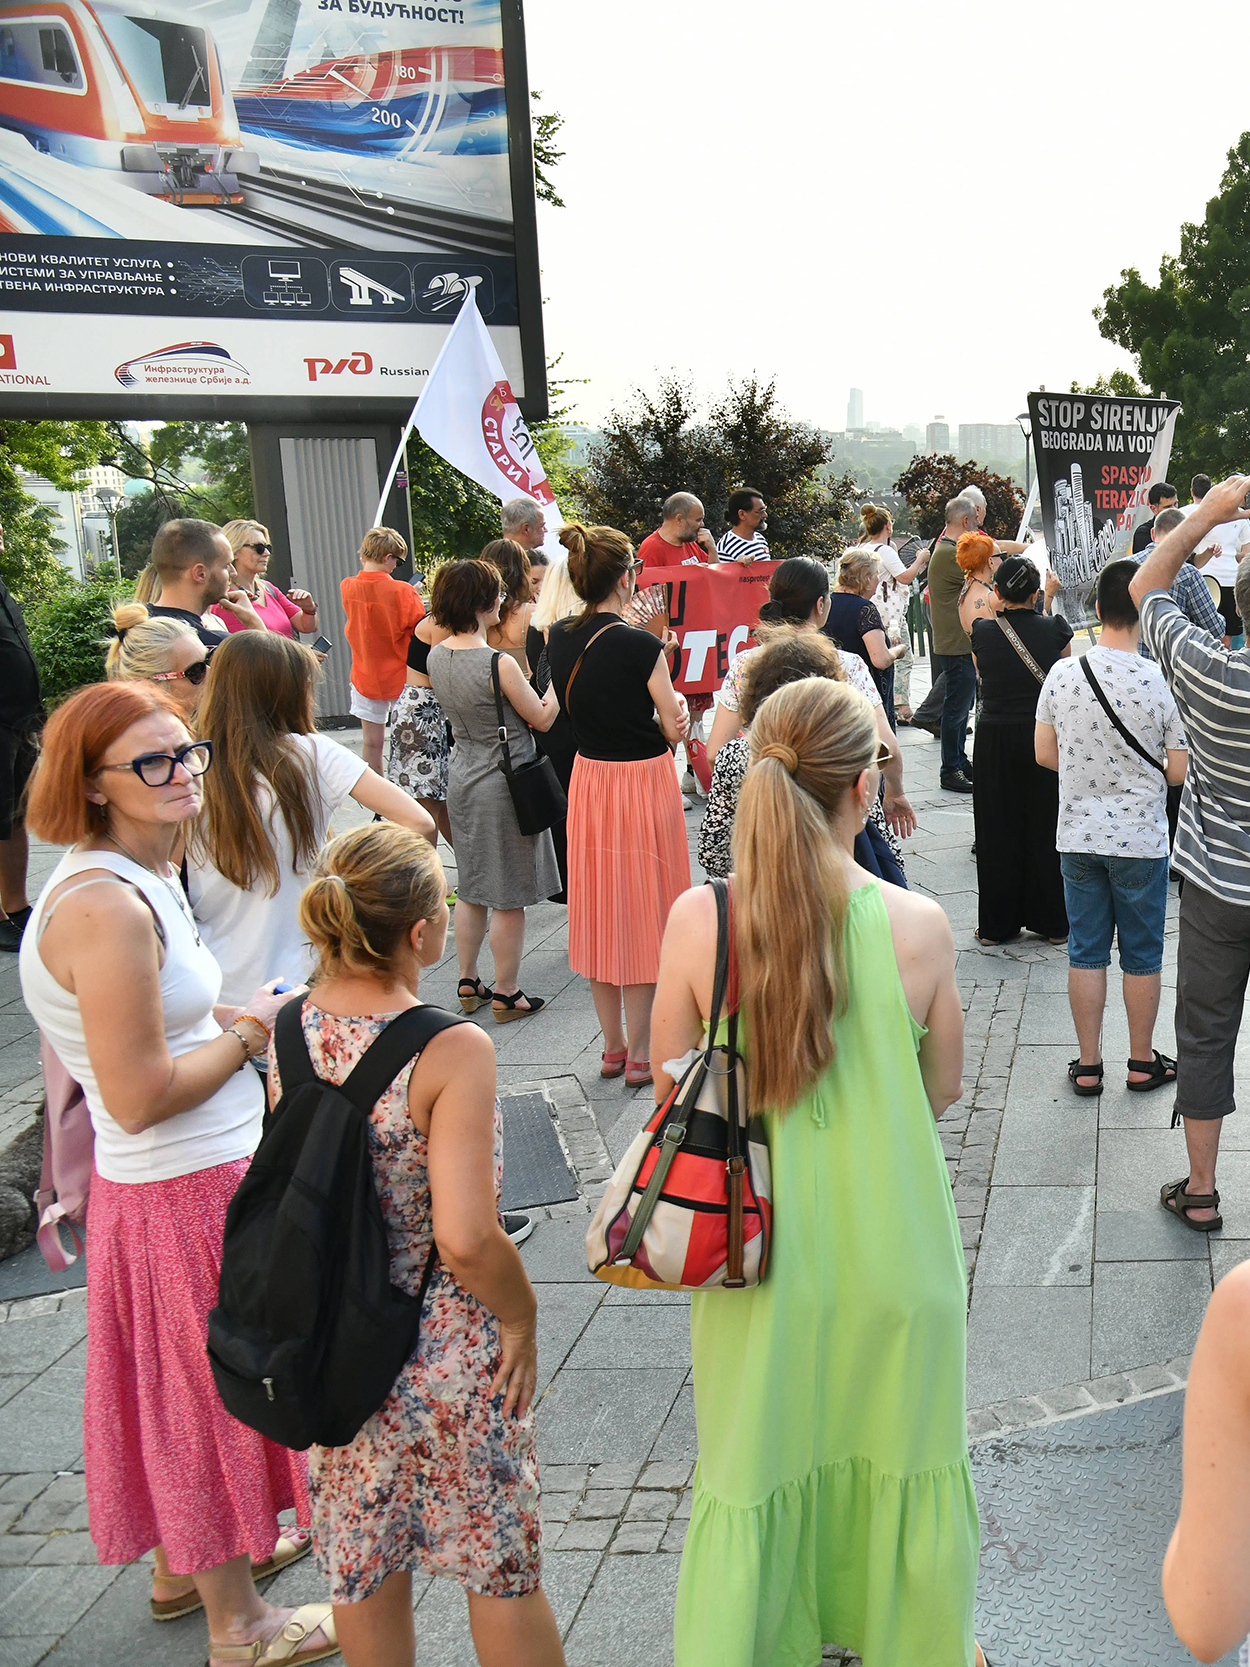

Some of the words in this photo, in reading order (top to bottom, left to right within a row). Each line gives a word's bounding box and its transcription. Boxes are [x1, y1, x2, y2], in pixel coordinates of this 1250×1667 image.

[318, 0, 342, 12] ЗА
[349, 0, 464, 24] БУДУЋНОСТ!
[394, 65, 416, 80] 180
[371, 107, 401, 129] 200
[41, 255, 109, 267] КВАЛИТЕТ
[113, 258, 162, 269] УСЛУГА
[59, 269, 76, 279] ЗА
[79, 270, 163, 283] УПРАВЉАЊЕ
[45, 282, 165, 296] ИНФРАСТРУКТУРА
[144, 364, 225, 375] Инфраструктура
[380, 366, 430, 376] Russian
[145, 376, 197, 385] железнице
[200, 375, 232, 386] Србије
[235, 376, 252, 386] а.д.
[1037, 398, 1085, 429] STOP
[1040, 431, 1103, 452] BEOGRADA
[1106, 434, 1125, 452] NA
[1127, 435, 1156, 453] VOD
[1006, 628, 1026, 654] JACOBS
[1023, 654, 1039, 673] MARC
